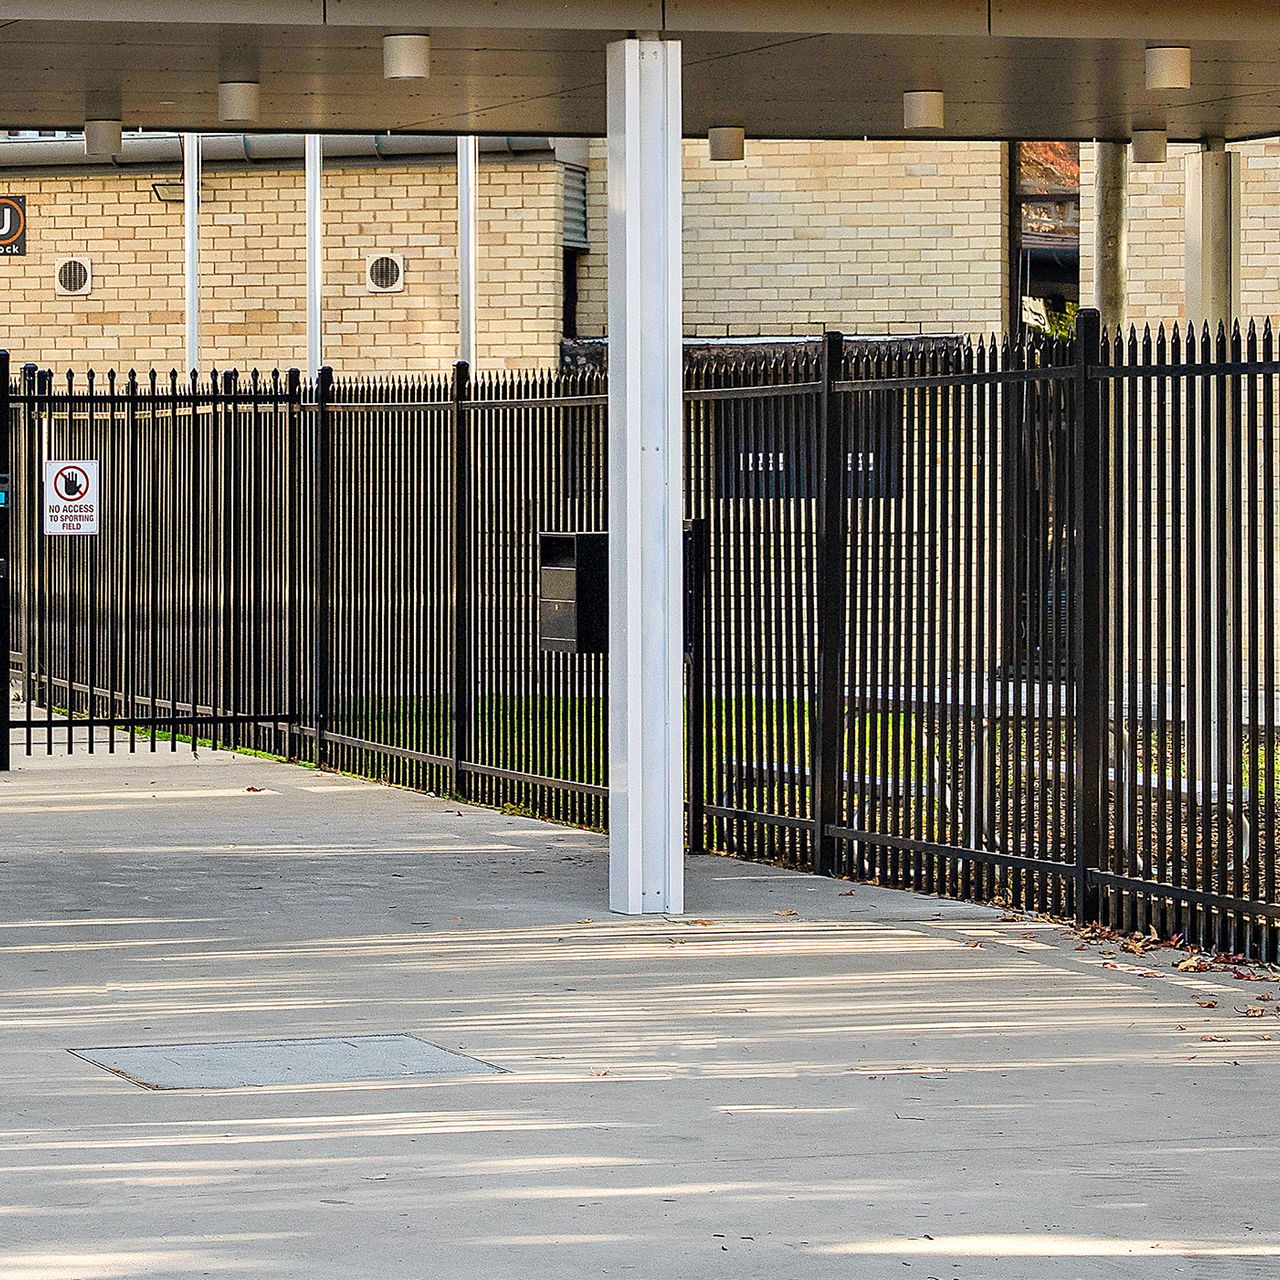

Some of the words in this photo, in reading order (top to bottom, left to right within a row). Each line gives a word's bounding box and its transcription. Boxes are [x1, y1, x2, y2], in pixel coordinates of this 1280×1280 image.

[48, 504, 60, 513] NO
[62, 504, 94, 513] ACCESS
[49, 514, 59, 522] TO
[60, 514, 94, 522] SPORTING
[62, 522, 82, 530] FIELD
